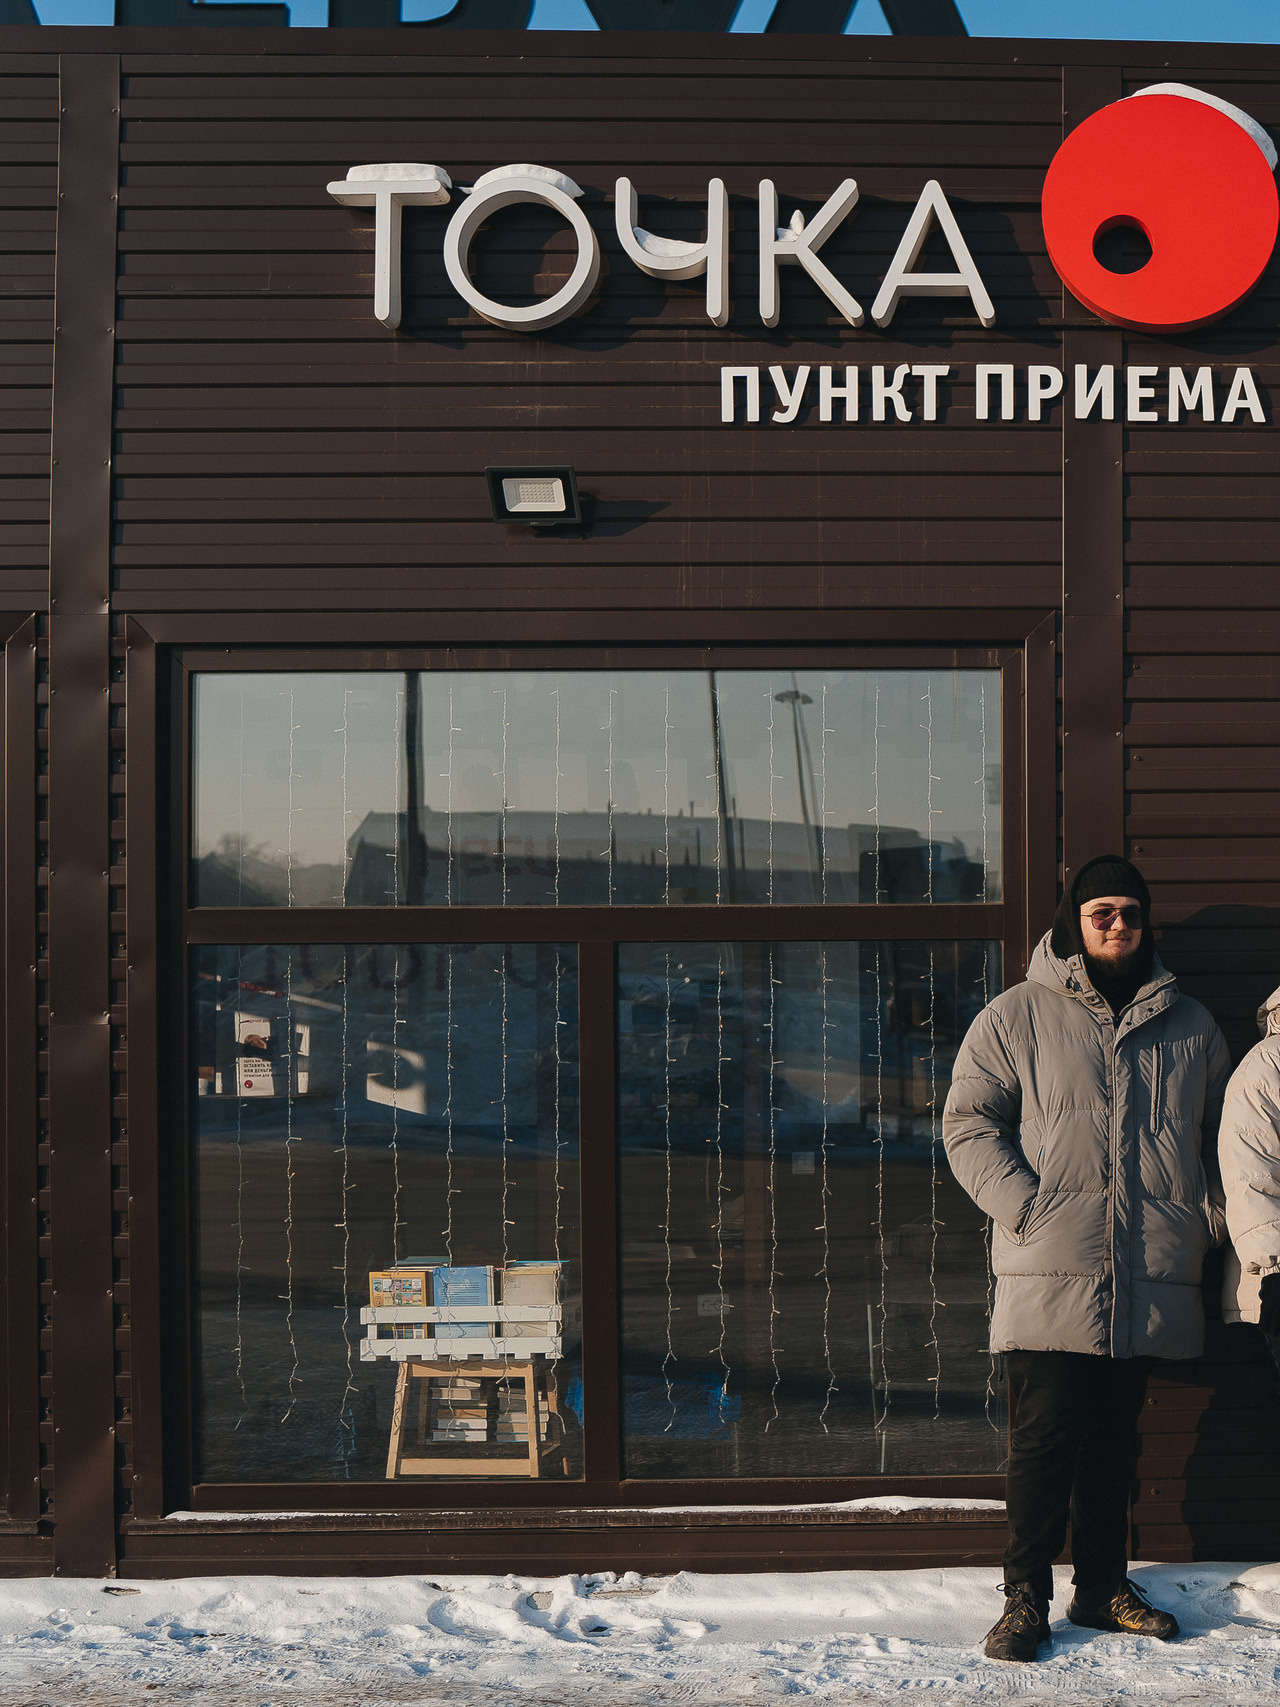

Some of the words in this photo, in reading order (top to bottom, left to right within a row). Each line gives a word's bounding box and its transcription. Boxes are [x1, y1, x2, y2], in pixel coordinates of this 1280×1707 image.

[326, 176, 996, 332] ТОЧКА
[720, 364, 951, 424] ПУНКТ
[975, 363, 1267, 424] ПРИЕМА
